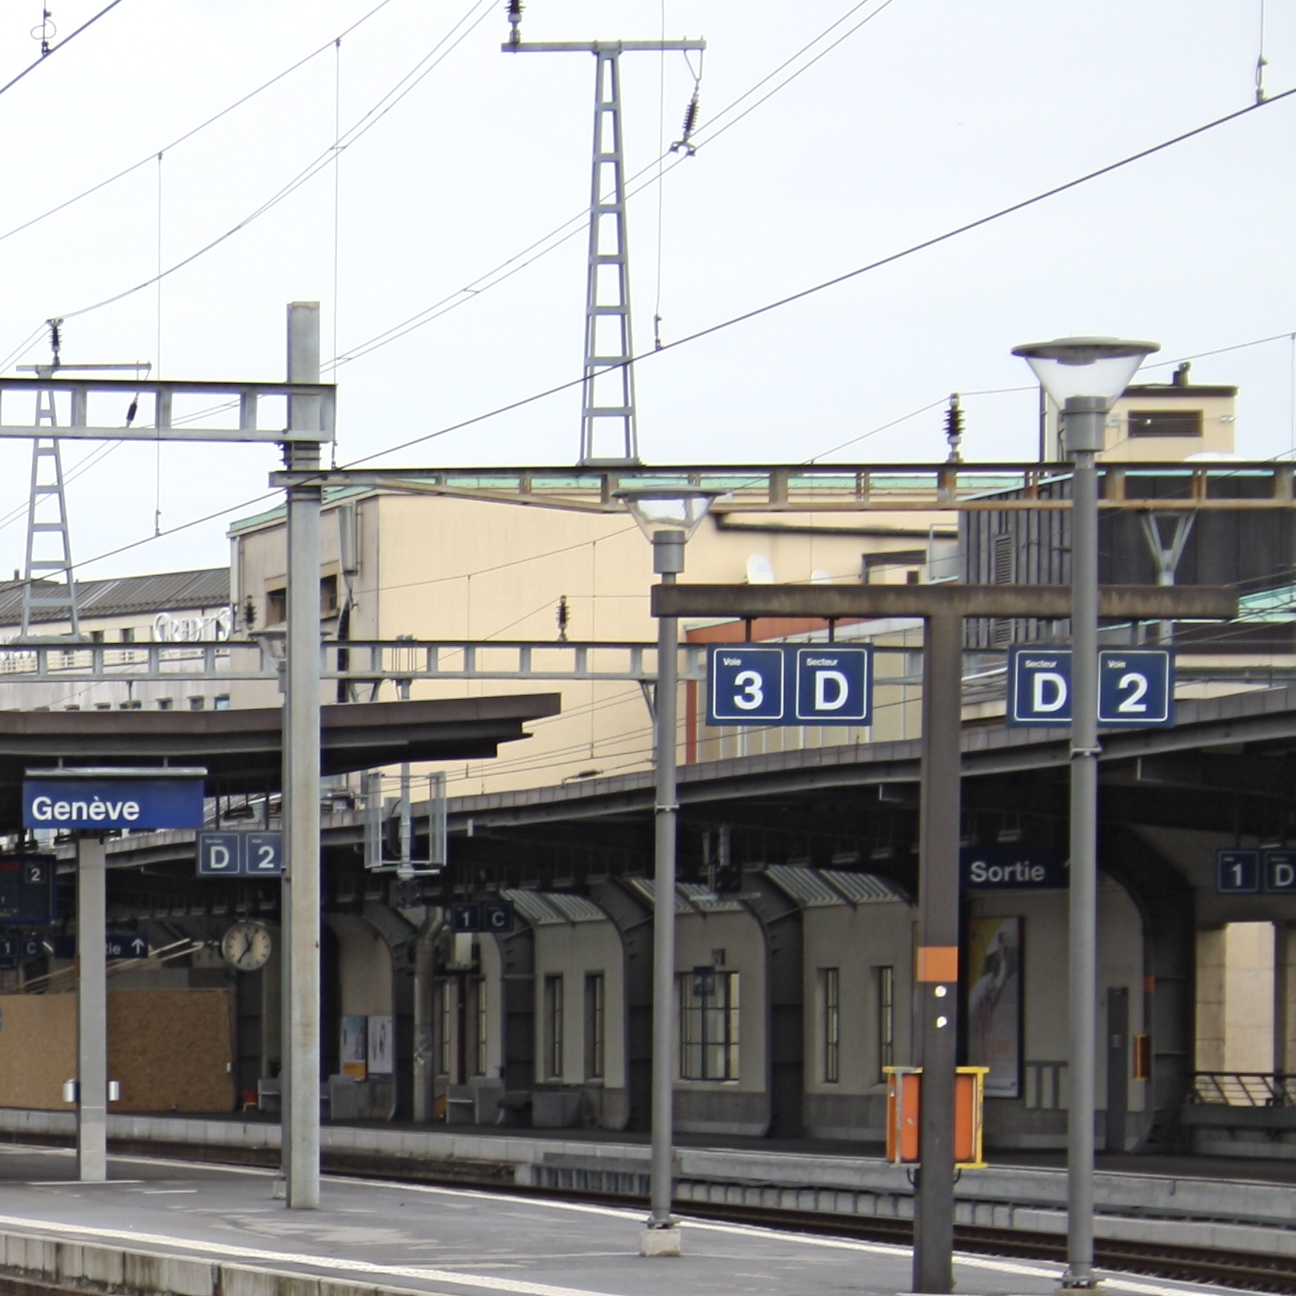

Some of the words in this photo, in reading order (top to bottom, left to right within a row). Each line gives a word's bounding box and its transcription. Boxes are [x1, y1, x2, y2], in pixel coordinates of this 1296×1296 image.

[722, 658, 742, 667] Voie
[806, 658, 839, 667] Secteur
[1107, 660, 1127, 669] Voie
[733, 670, 764, 711] 3
[814, 670, 849, 711] D
[1033, 672, 1068, 712] D
[1118, 672, 1148, 713] 2
[31, 795, 140, 821] Genève
[210, 845, 230, 869] D
[258, 845, 275, 869] 2
[30, 868, 41, 882] 2
[970, 860, 1046, 883] Sortie
[1231, 863, 1242, 886] 1
[1275, 863, 1295, 887] D
[462, 911, 470, 928] 1
[491, 911, 505, 928] C
[3, 942, 11, 954] 1
[26, 942, 37, 954] C
